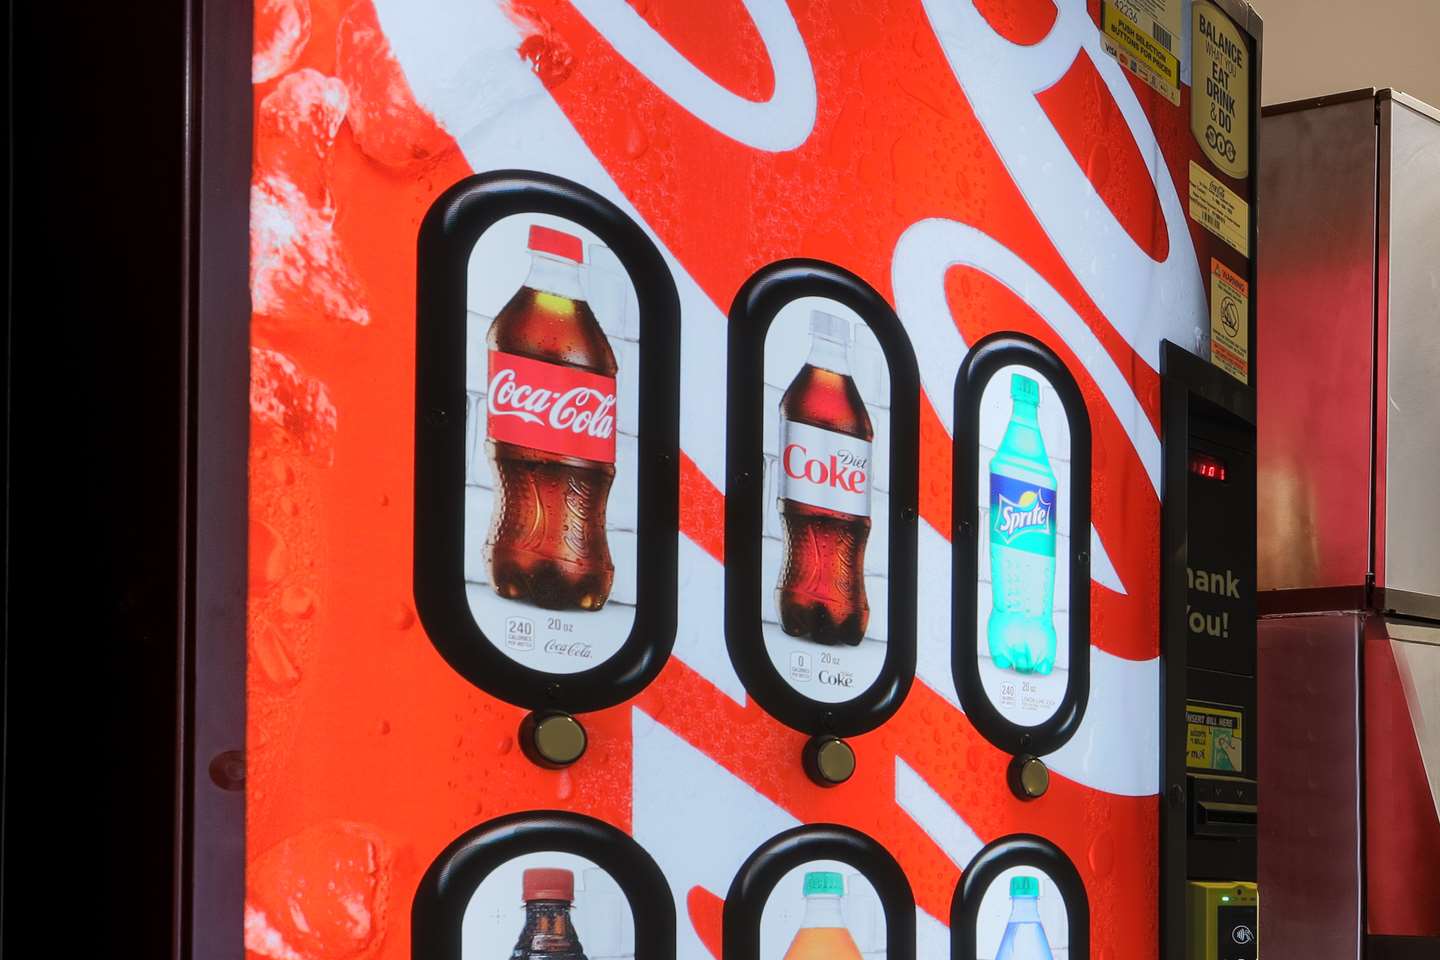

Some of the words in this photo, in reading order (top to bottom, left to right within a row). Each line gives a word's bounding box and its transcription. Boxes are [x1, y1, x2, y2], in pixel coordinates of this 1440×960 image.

[1110, 24, 1140, 51] BUTTONS
[1140, 46, 1152, 61] FOR
[1152, 57, 1172, 78] PRICES
[1118, 19, 1135, 37] PUSH
[1135, 33, 1168, 63] SELECTION
[1199, 14, 1242, 69] BALANCE
[1205, 42, 1223, 64] WHAT
[1225, 58, 1237, 78] YOU
[1212, 61, 1229, 91] EAT
[1206, 77, 1236, 119] DRINK
[1210, 102, 1217, 122] &
[1218, 110, 1232, 134] DO
[487, 369, 616, 439] Coca-Cola
[783, 443, 865, 494] Coke
[838, 449, 867, 470] Diet
[1000, 502, 1046, 535] Sprite
[509, 620, 532, 635] 240
[547, 617, 561, 631] 20
[544, 639, 593, 659] Coca-Cola
[798, 655, 805, 667] 0
[821, 652, 831, 664] 20
[818, 670, 853, 687] Coke
